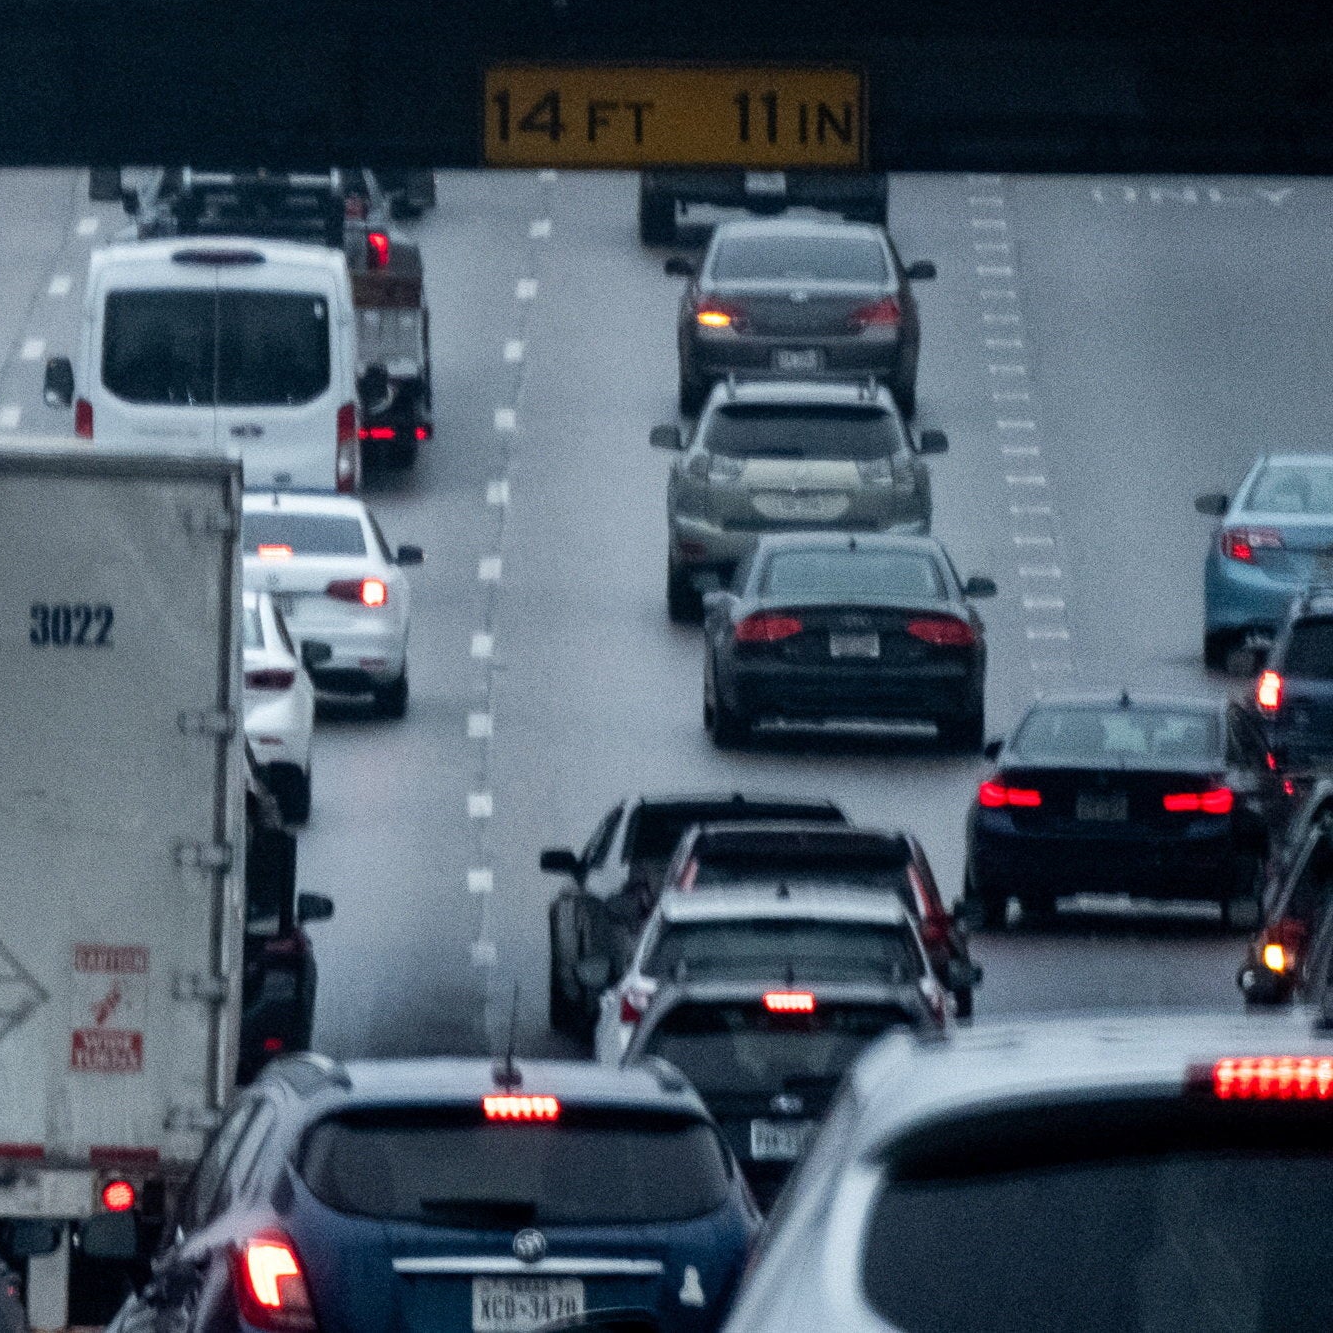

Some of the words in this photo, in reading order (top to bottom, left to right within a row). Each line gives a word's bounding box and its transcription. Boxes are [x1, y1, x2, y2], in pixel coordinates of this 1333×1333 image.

[493, 89, 565, 141] 14
[588, 100, 653, 144] FT
[734, 91, 777, 144] 11
[799, 102, 852, 143] IN
[30, 605, 113, 646] 3022
